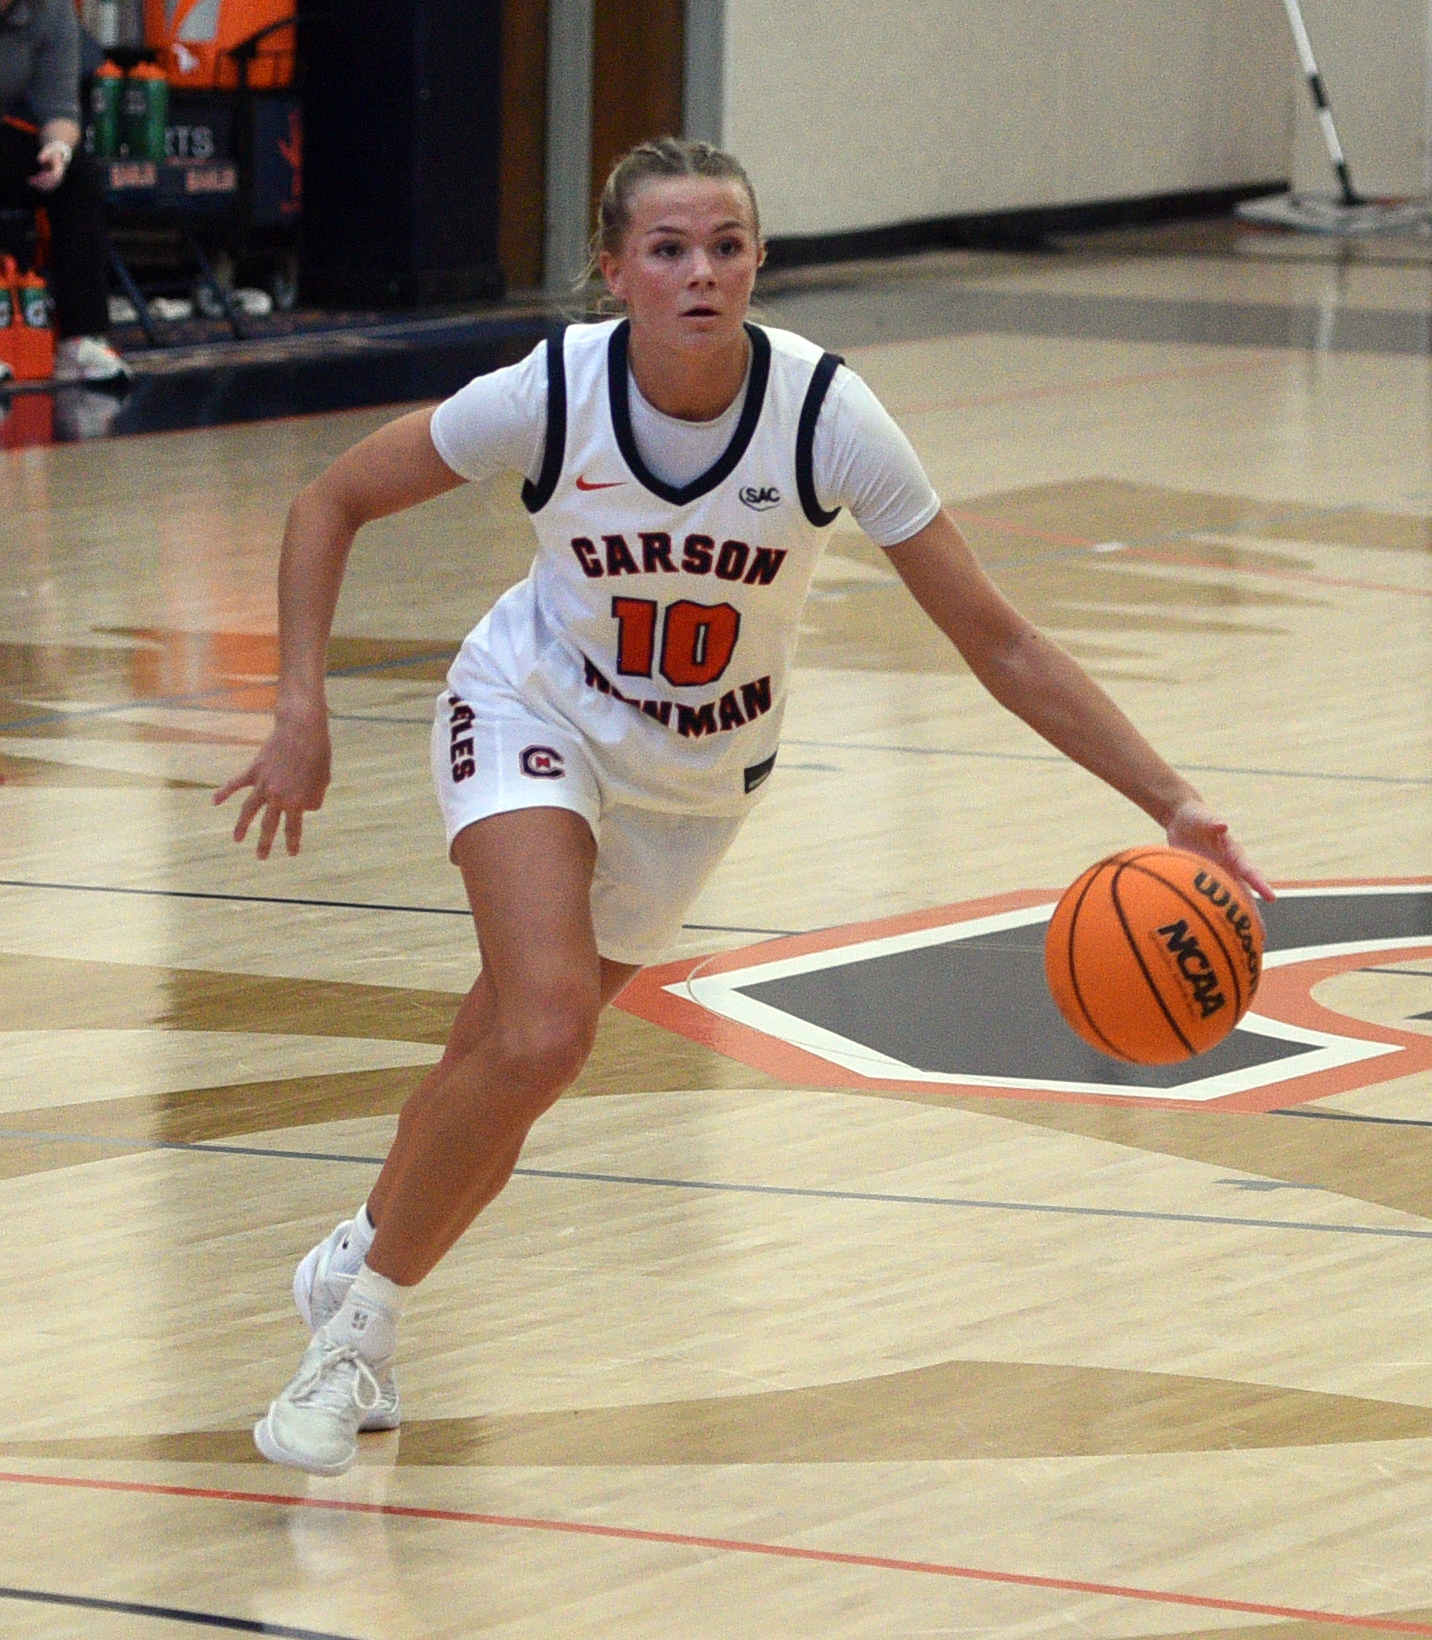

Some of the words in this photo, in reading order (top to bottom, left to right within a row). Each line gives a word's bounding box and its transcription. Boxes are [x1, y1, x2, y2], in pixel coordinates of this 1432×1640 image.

[746, 487, 780, 503] SAC
[571, 532, 788, 586] CARSON
[612, 596, 741, 687] 10
[1156, 918, 1227, 1020] NCAA
